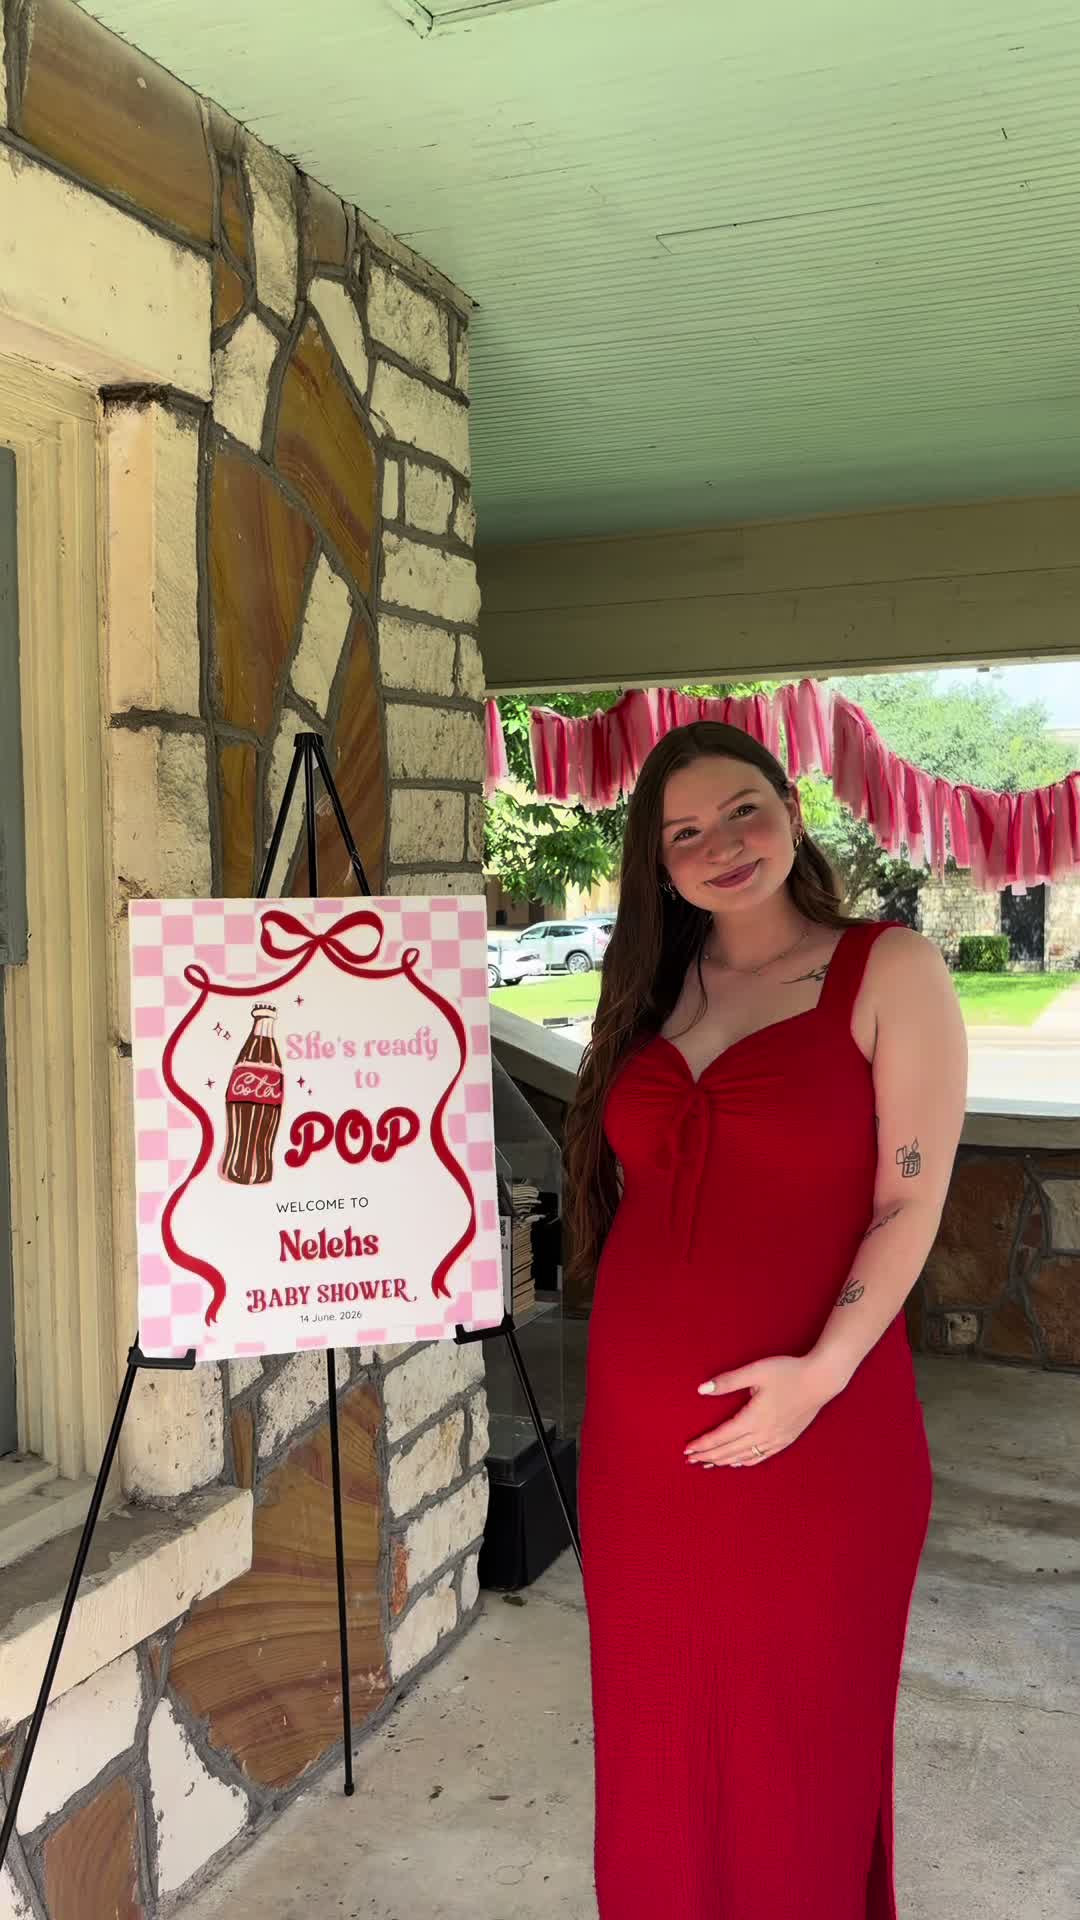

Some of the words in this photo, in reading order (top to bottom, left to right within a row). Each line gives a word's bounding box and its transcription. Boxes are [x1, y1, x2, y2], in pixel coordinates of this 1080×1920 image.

[286, 1031, 356, 1060] She's
[364, 1026, 438, 1060] ready
[354, 1069, 381, 1089] to
[284, 1106, 421, 1168] POP
[276, 1198, 345, 1213] WELCOME
[350, 1197, 369, 1208] TO
[278, 1225, 380, 1262] Nelehs
[246, 1286, 311, 1313] BABY
[317, 1278, 418, 1303] SHOWER
[300, 1315, 309, 1323] 14
[340, 1311, 362, 1320] 2026
